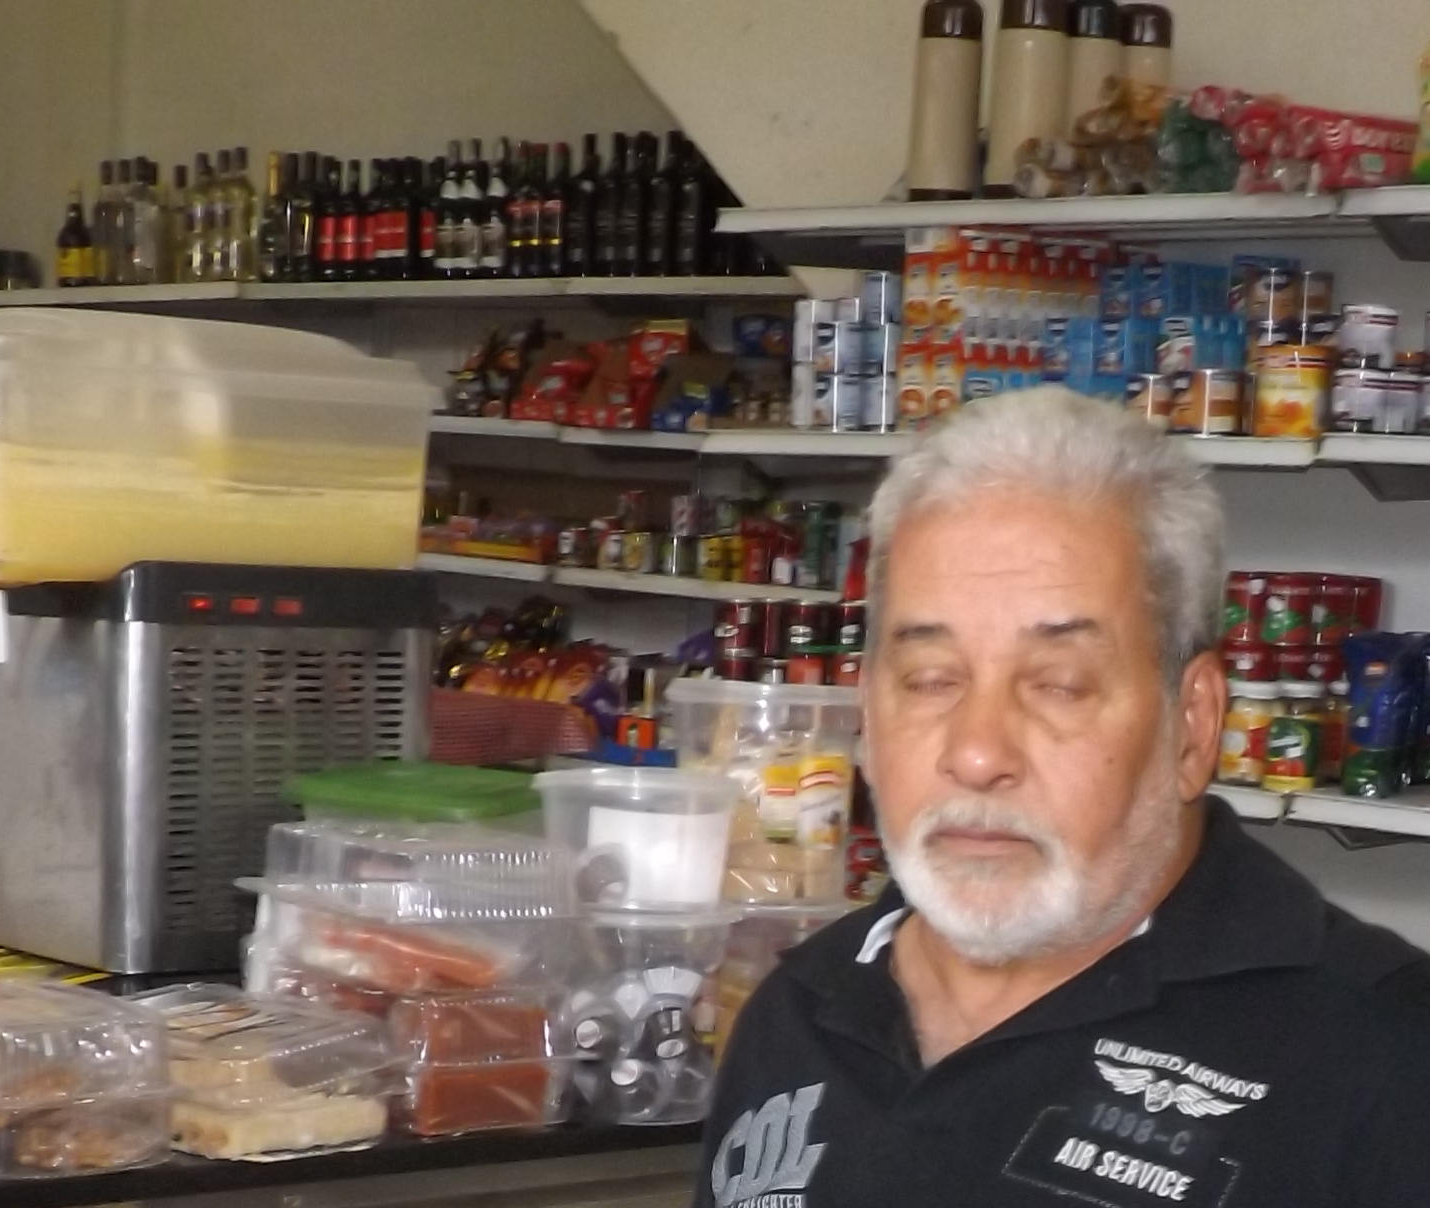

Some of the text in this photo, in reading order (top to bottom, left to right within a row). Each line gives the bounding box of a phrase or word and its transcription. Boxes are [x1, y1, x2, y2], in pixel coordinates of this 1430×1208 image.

[1094, 1038, 1269, 1100] UNLIMITED AIRWAYS
[1053, 1137, 1196, 1201] AIR SERVICE
